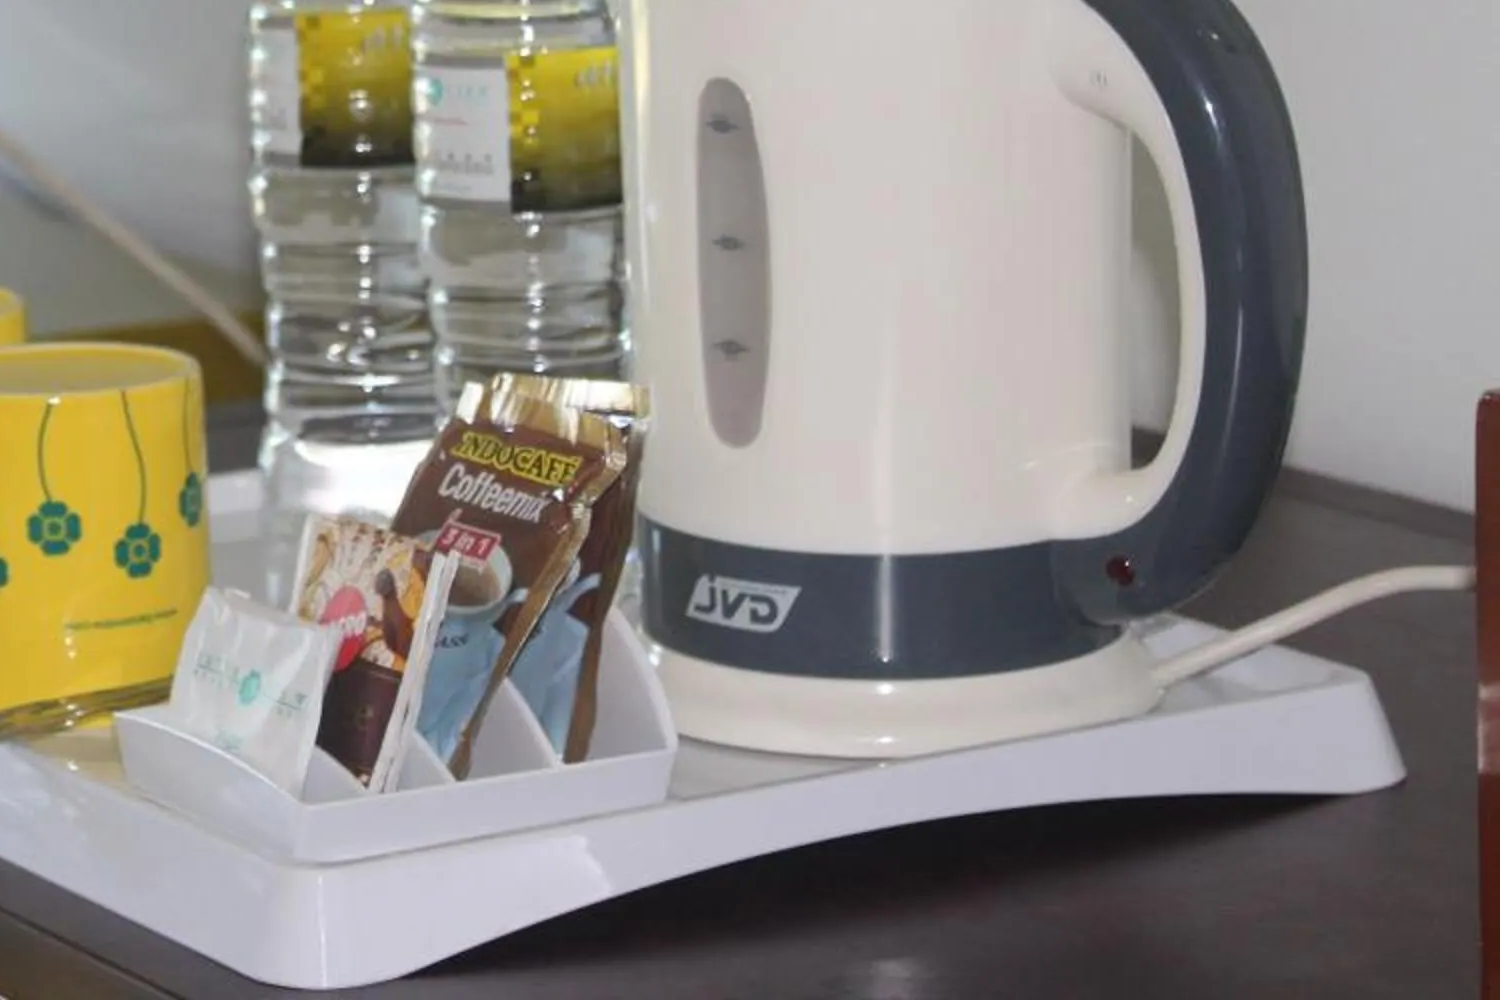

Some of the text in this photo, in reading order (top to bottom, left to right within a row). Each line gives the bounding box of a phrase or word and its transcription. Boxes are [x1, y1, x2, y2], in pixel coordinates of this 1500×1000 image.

[438, 464, 550, 523] Coffeemix
[441, 528, 457, 545] 3
[476, 537, 488, 554] 1
[693, 575, 779, 625] JVD
